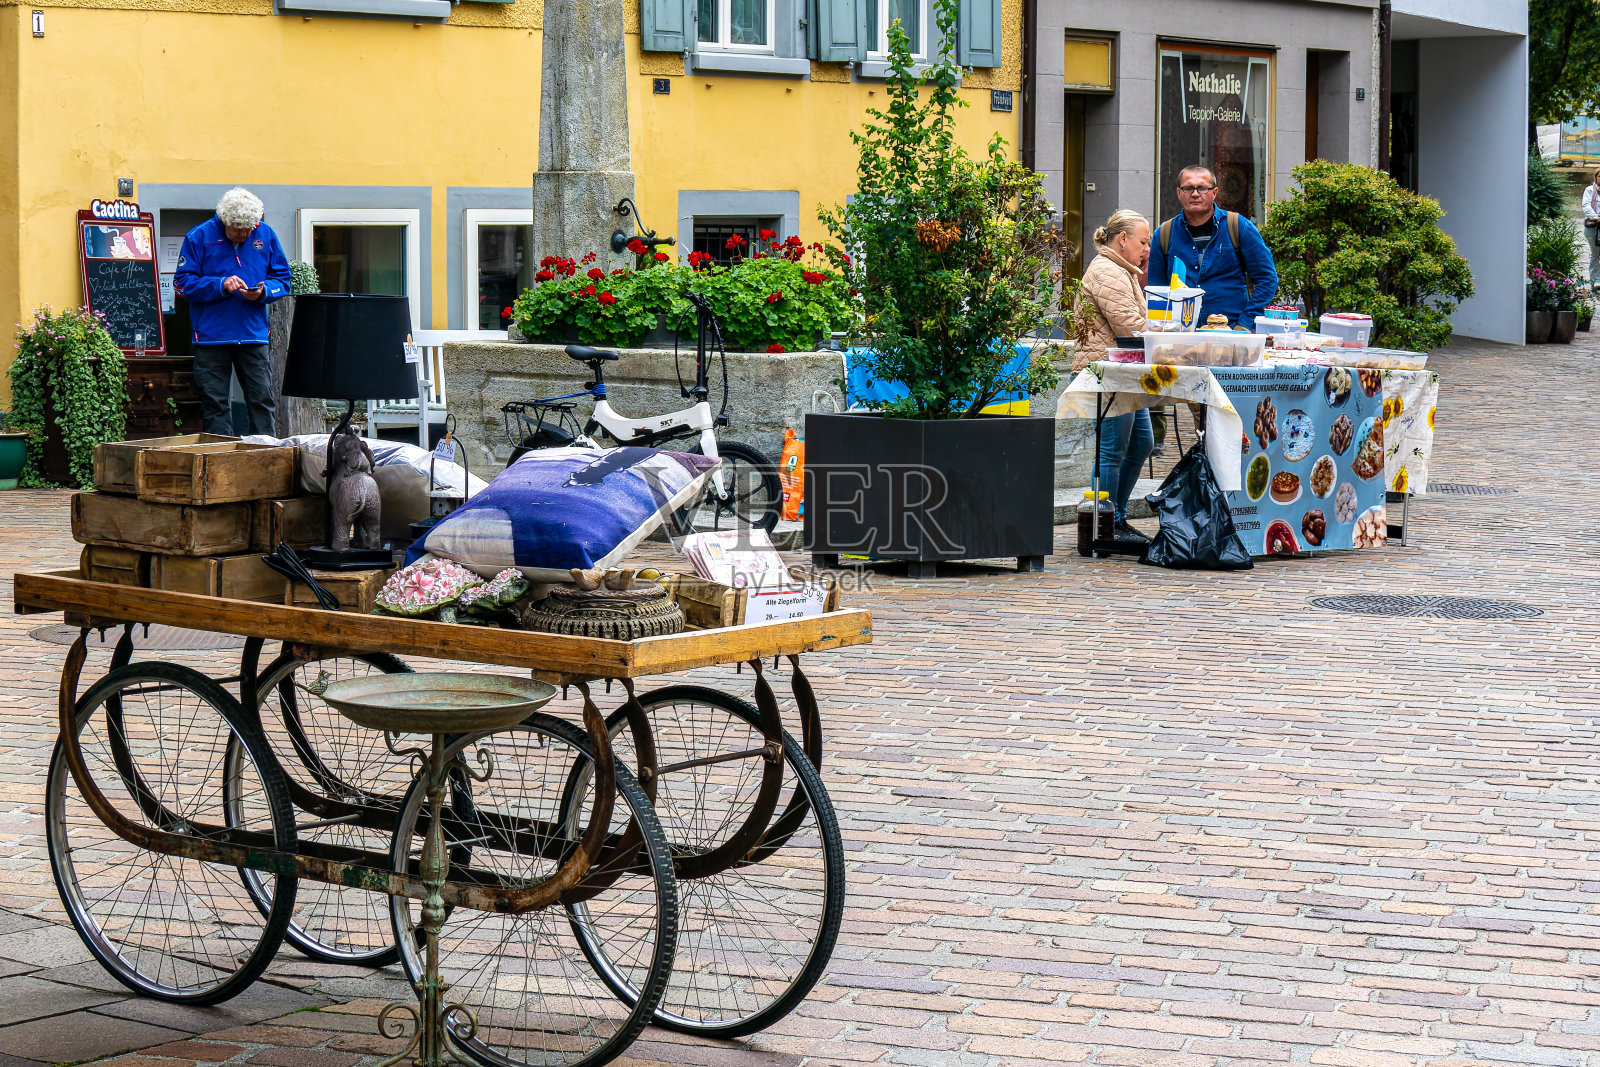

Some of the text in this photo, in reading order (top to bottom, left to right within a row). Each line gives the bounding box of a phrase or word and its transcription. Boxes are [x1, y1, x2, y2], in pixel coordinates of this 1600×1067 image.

[36, 15, 41, 32] 1
[659, 80, 665, 91] 3
[1188, 70, 1242, 95] Nathalie
[1188, 104, 1241, 123] Teppich-Galerie
[92, 200, 139, 220] Caotina
[121, 260, 145, 280] offen
[1276, 372, 1299, 380] FRISCHES
[660, 418, 674, 427] SKT
[777, 597, 807, 606] Ziegelform
